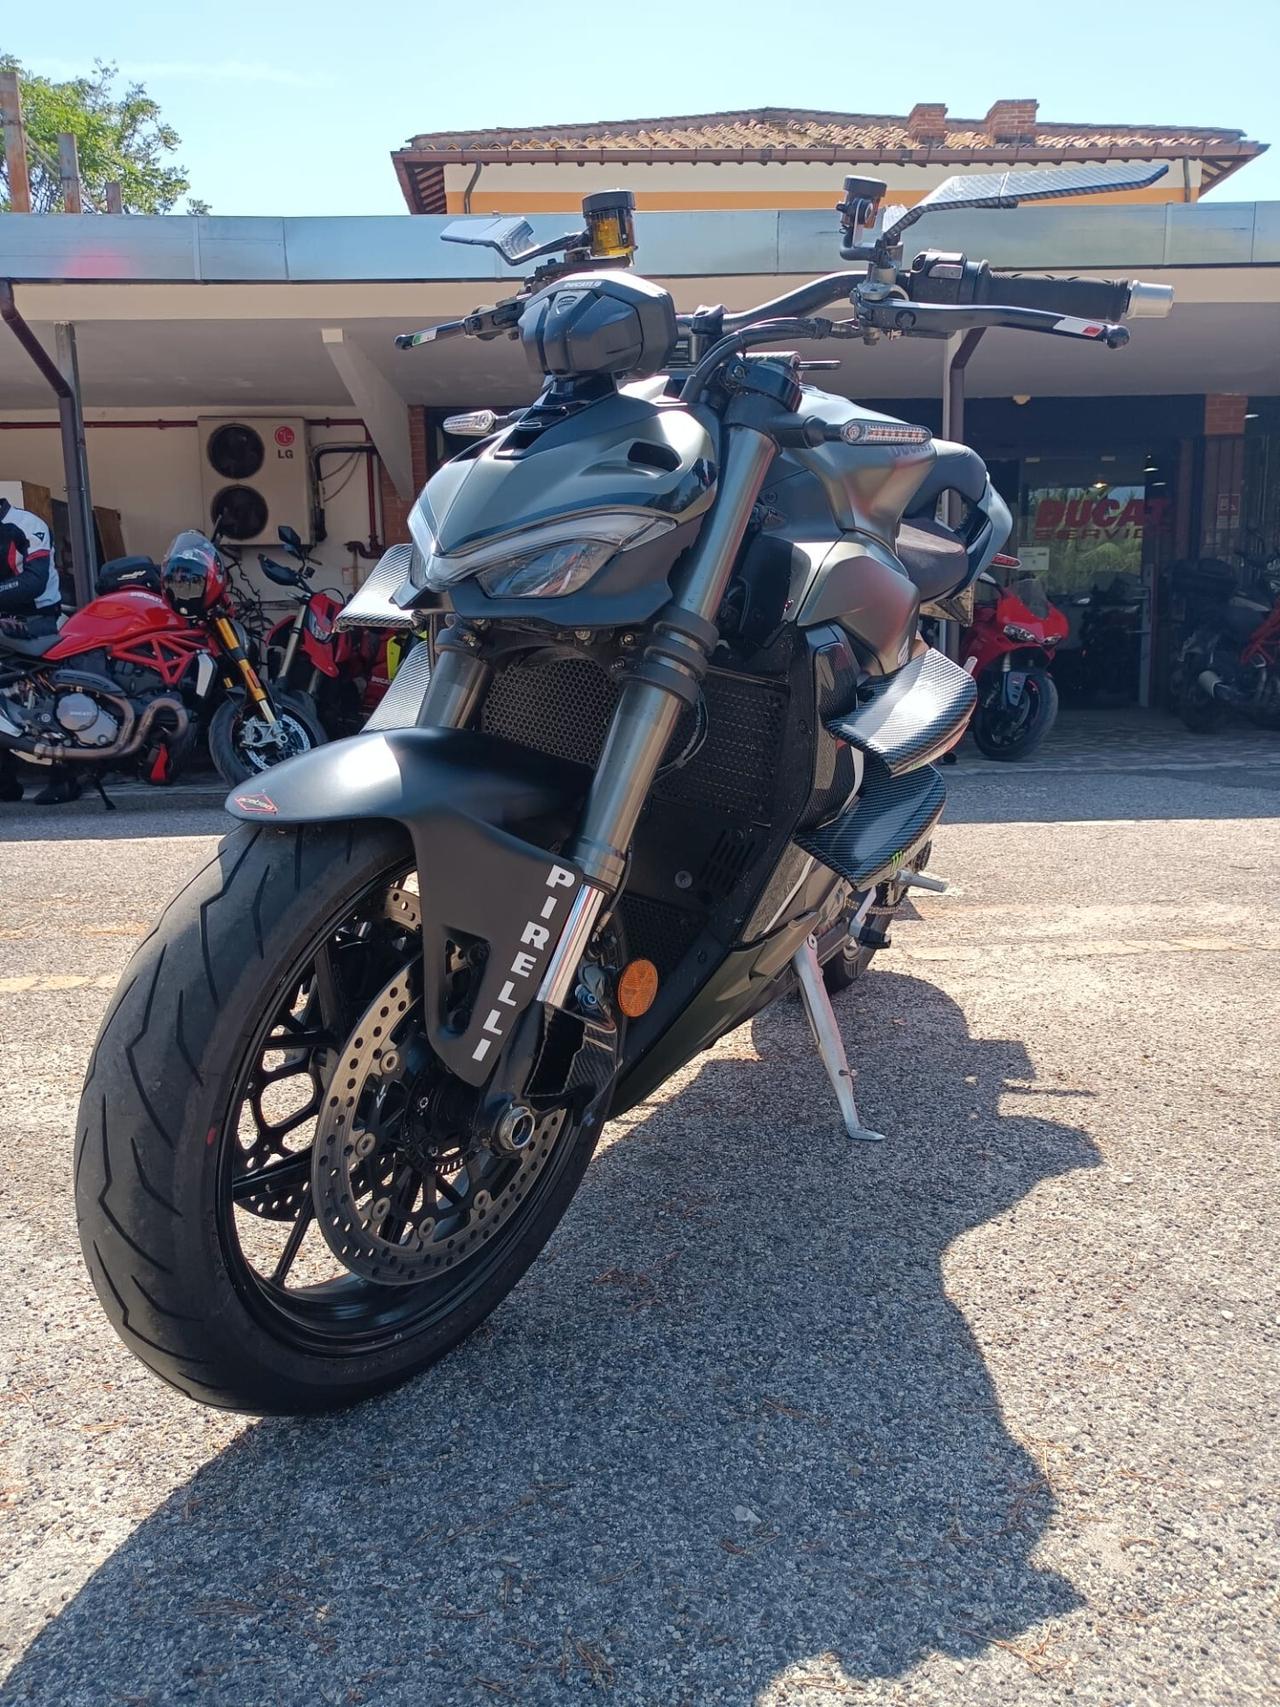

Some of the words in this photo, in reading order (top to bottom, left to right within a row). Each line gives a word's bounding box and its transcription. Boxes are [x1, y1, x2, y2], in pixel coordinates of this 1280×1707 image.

[278, 449, 293, 459] LG
[1035, 499, 1170, 528] DUCAT
[472, 864, 576, 1062] PIRELLI
